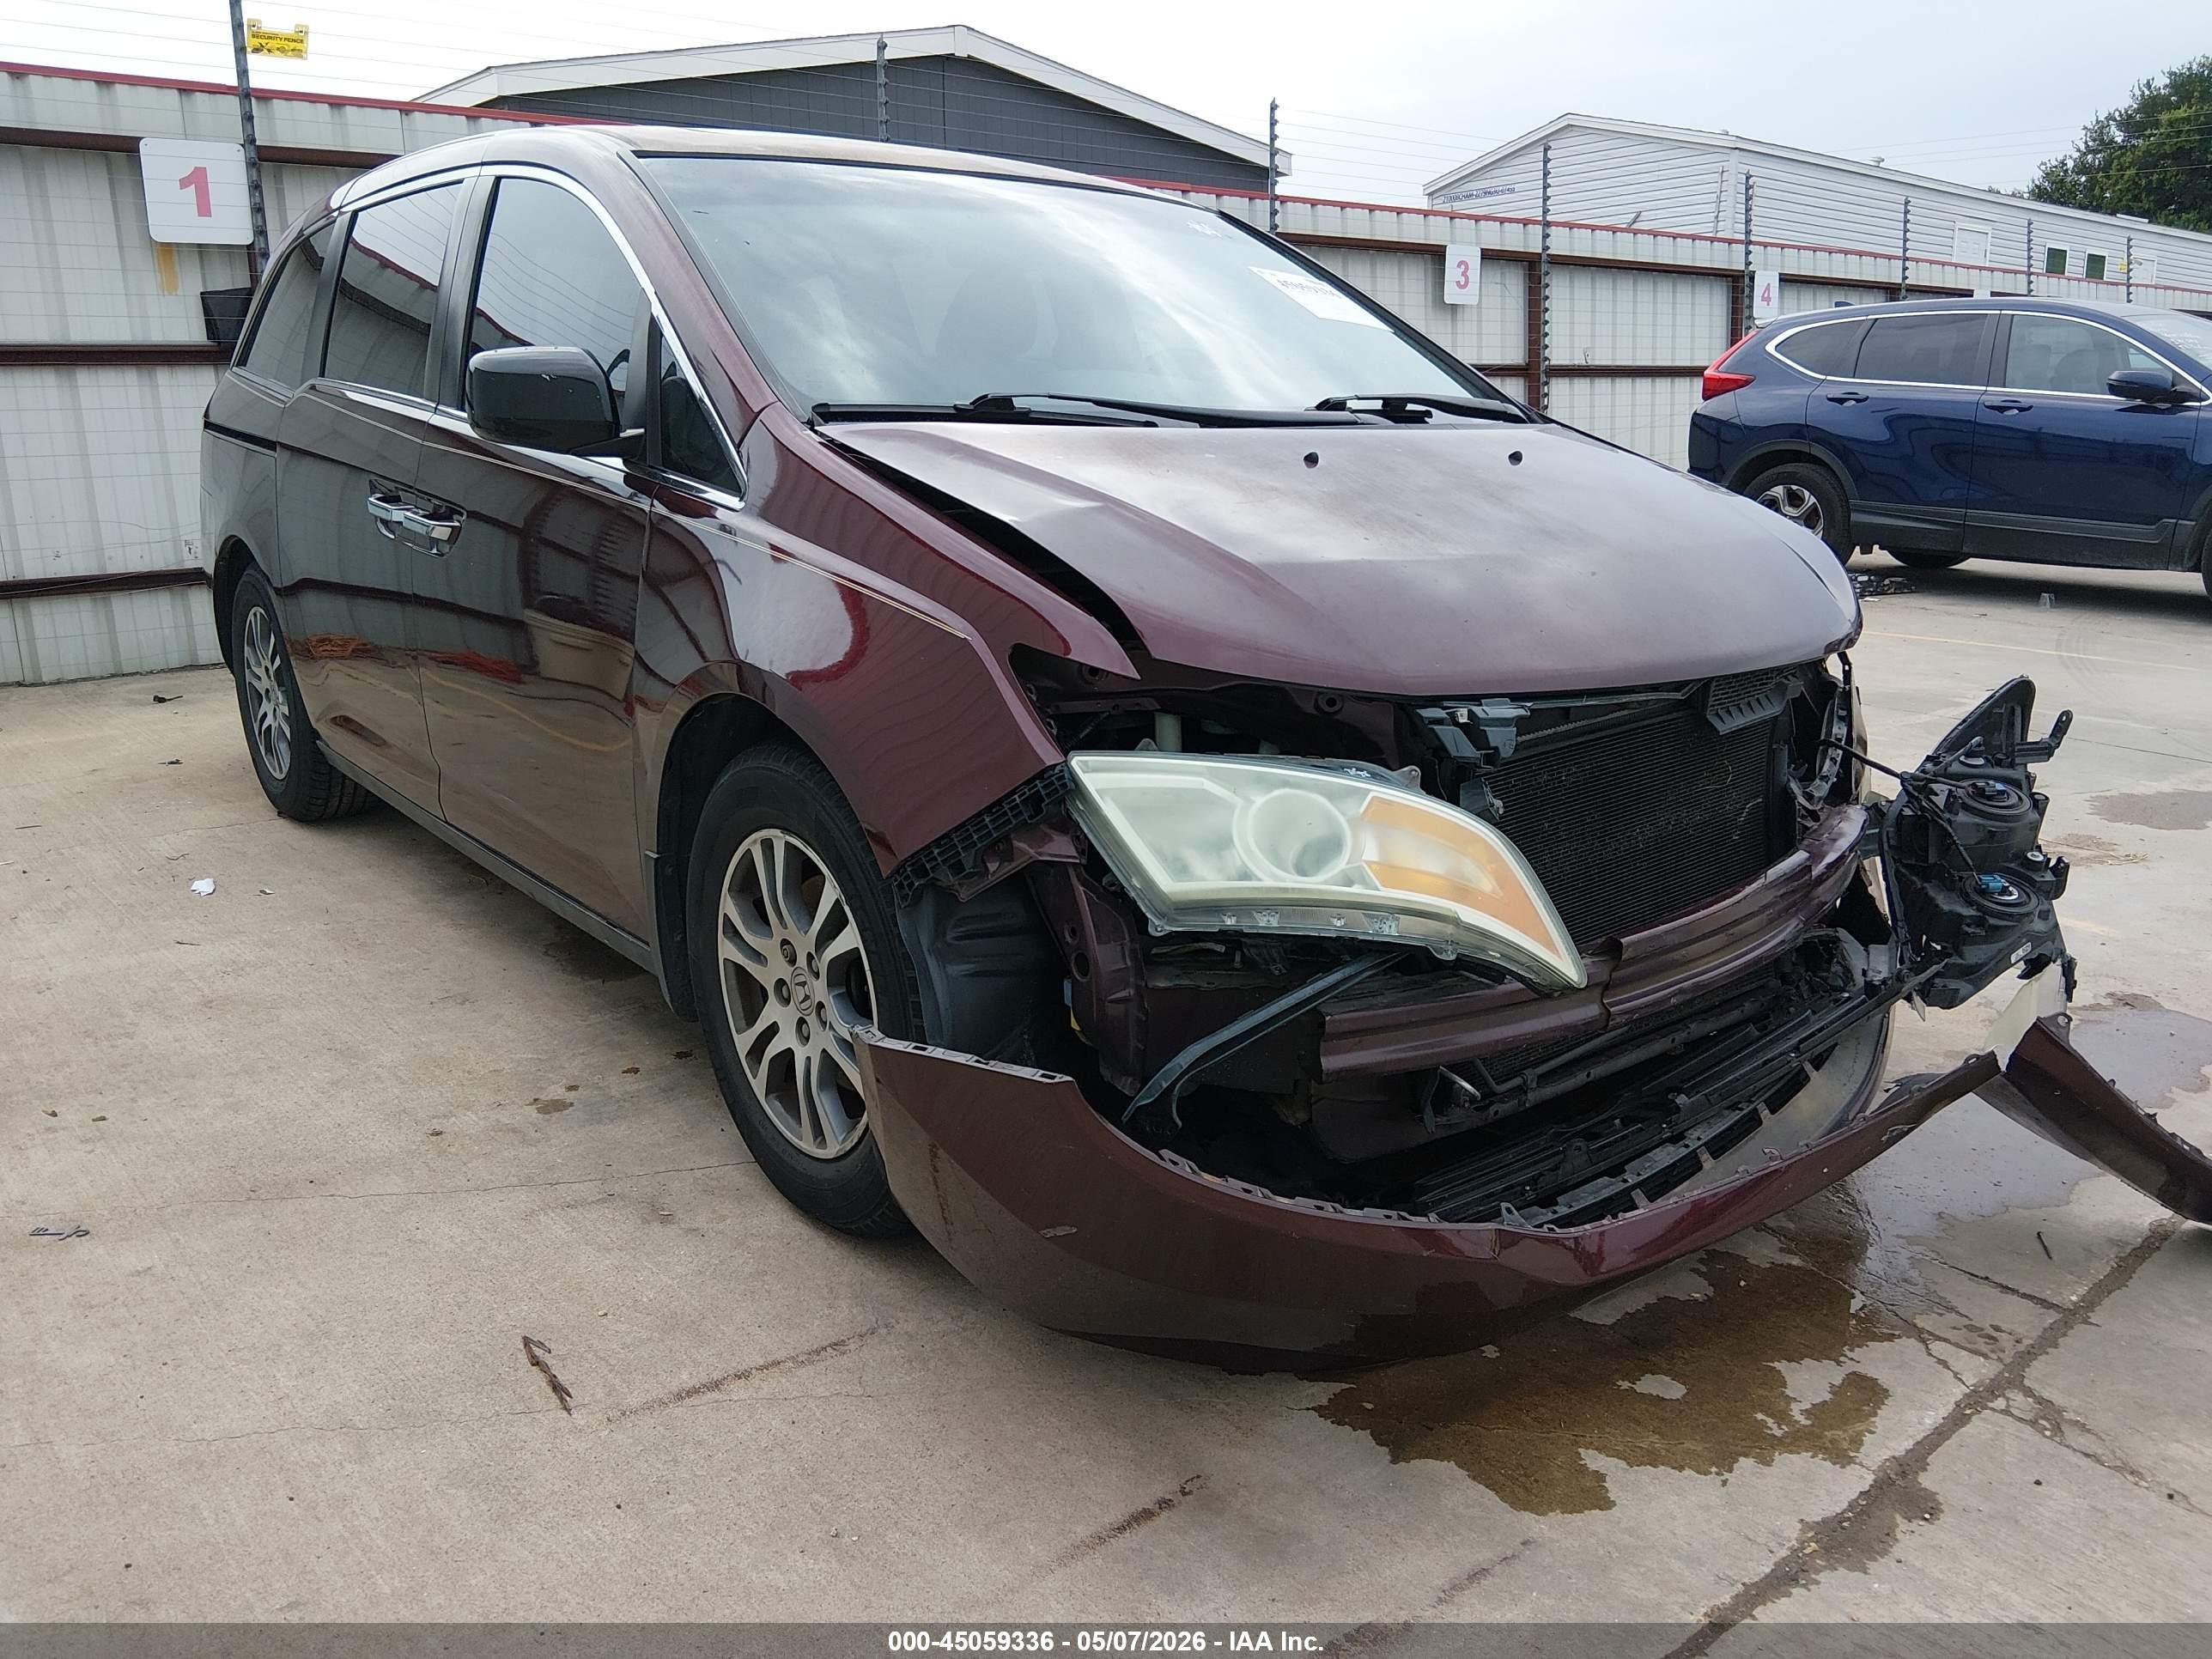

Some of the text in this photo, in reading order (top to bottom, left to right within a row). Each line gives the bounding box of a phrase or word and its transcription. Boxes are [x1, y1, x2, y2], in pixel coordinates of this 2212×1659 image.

[252, 33, 283, 42] SECURITY
[179, 166, 212, 217] 1
[1455, 259, 1470, 289] 3
[1760, 283, 1771, 307] 4
